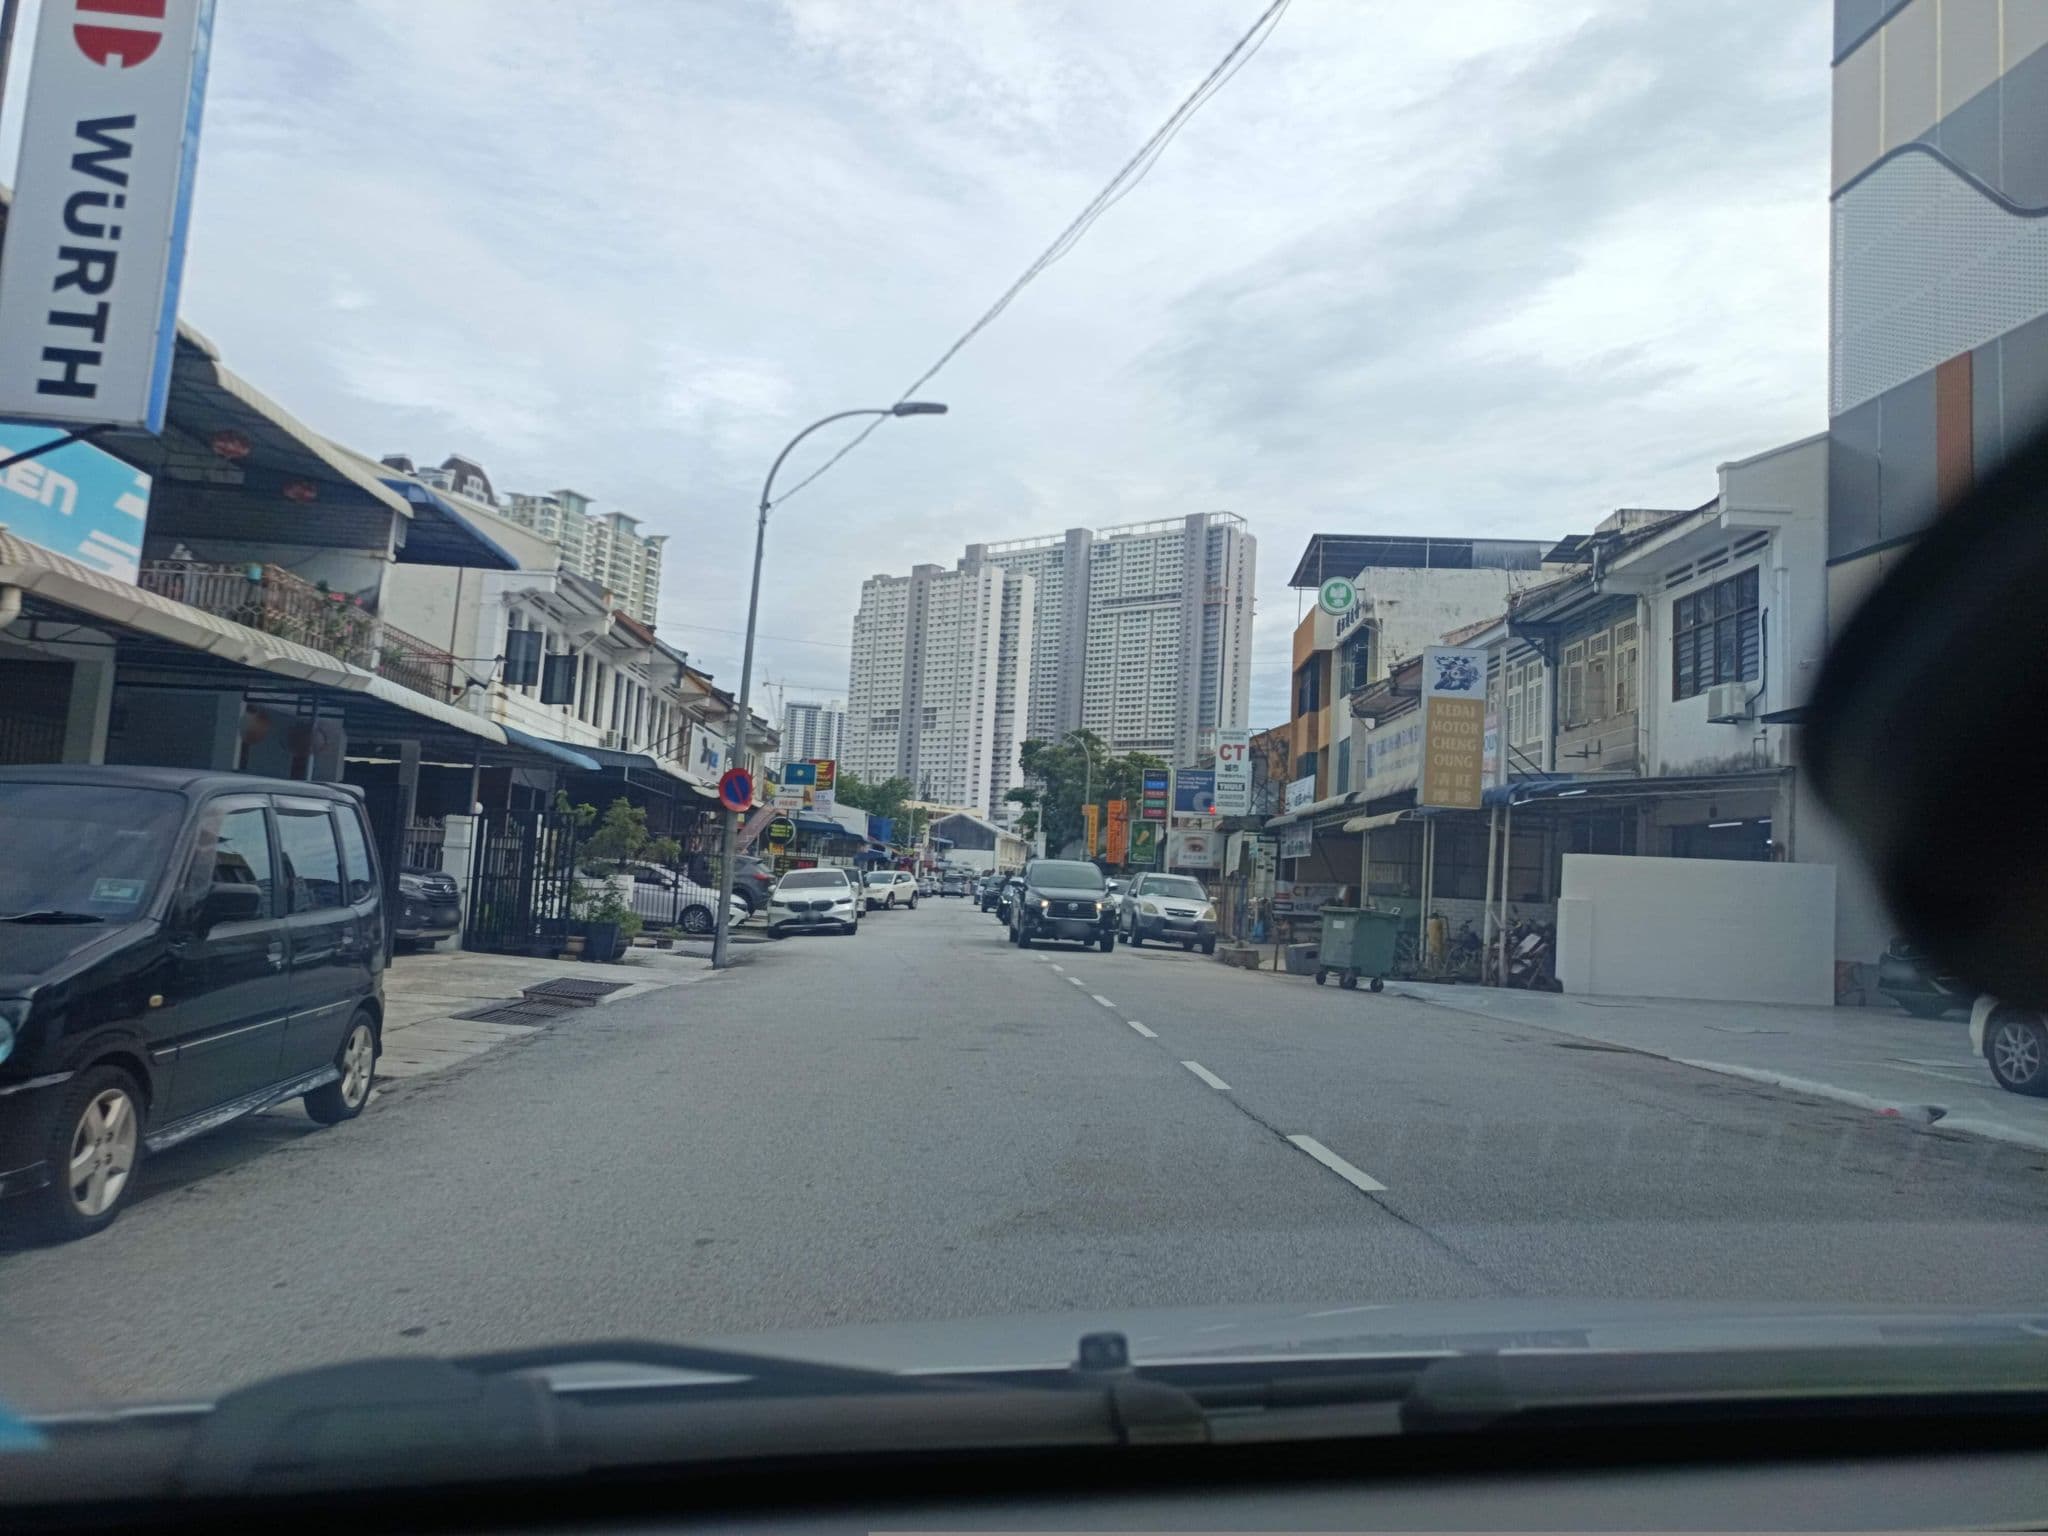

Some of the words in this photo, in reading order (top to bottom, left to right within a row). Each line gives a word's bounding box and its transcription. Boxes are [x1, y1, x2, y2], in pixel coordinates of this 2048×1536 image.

[36, 113, 136, 399] WÜRTH
[1435, 703, 1475, 718] KEDAI
[1431, 720, 1479, 735] MOTOR
[1219, 743, 1246, 761] CT
[1432, 736, 1476, 752] CHENG
[1433, 753, 1473, 769] OUNG
